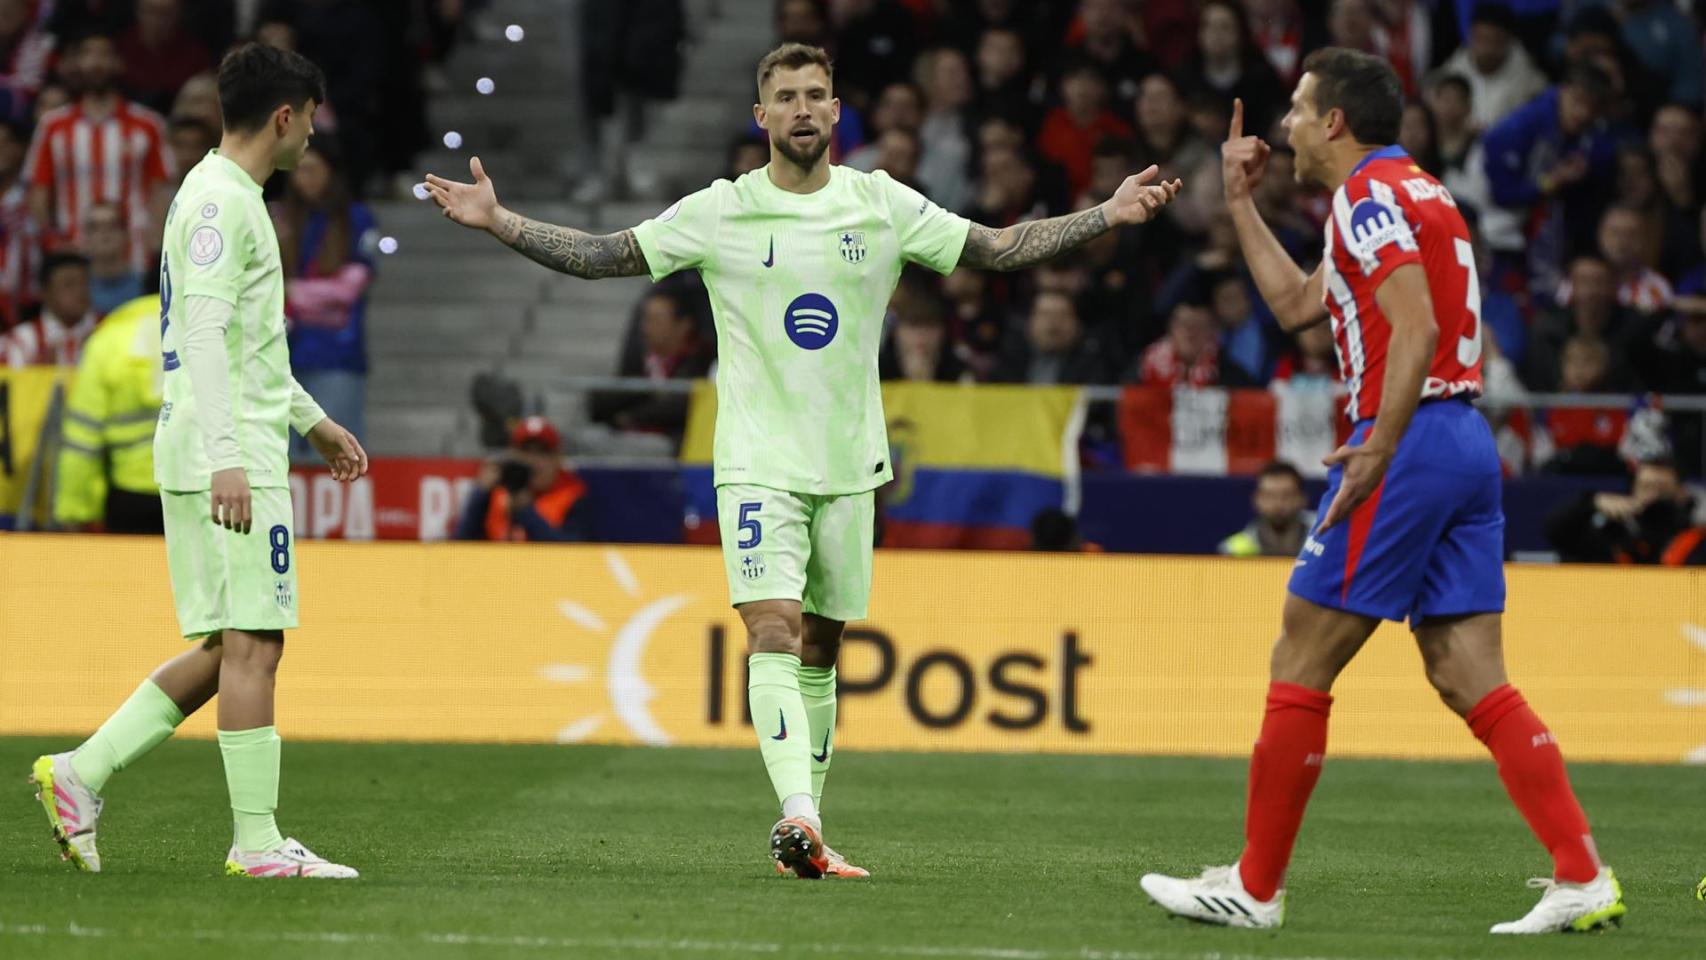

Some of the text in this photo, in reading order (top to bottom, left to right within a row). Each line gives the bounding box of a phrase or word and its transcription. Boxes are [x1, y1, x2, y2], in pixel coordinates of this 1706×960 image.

[1453, 237, 1482, 368] 3
[270, 525, 290, 574] 8
[738, 502, 762, 549] 5
[708, 624, 1094, 734] IPost
